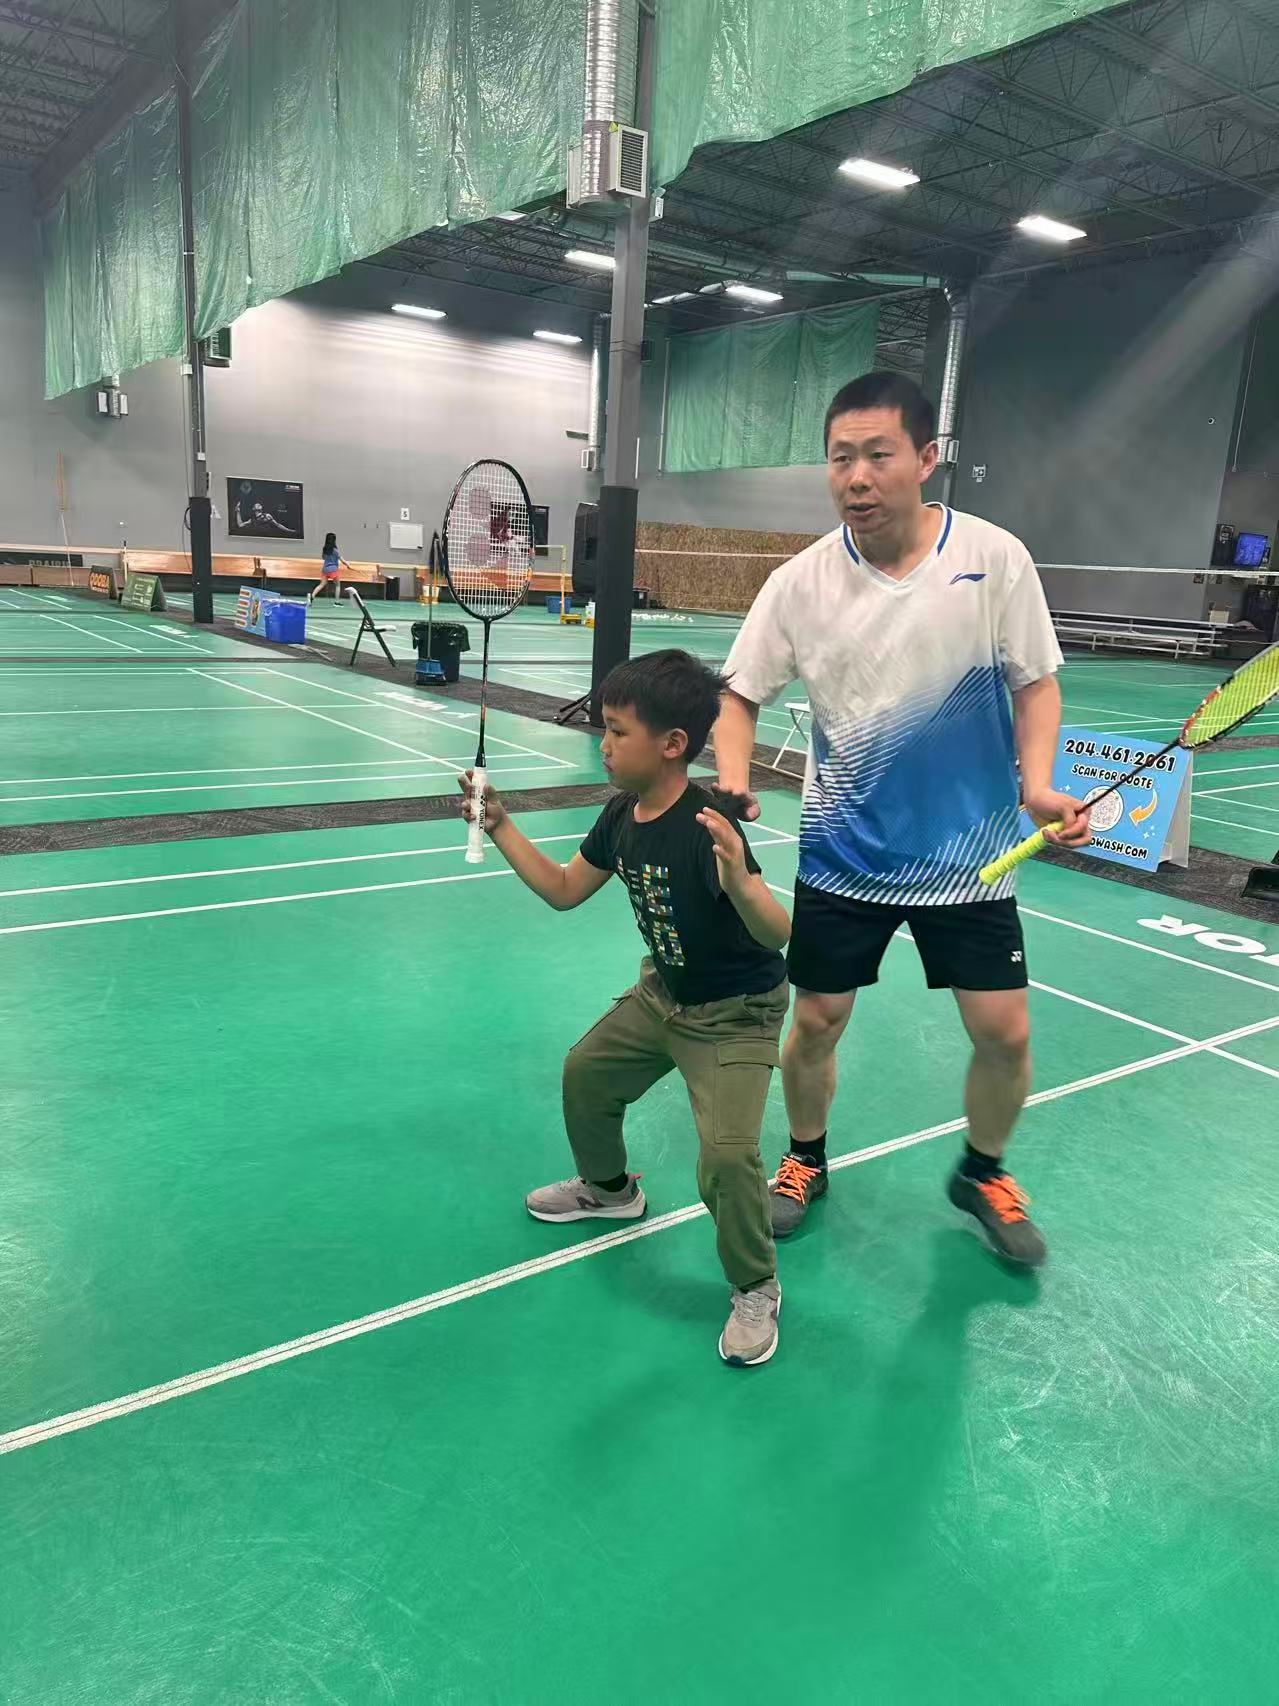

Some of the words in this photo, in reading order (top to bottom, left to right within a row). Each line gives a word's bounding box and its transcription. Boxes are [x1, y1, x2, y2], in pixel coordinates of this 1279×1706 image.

[1064, 739, 1177, 772] 204.461.2061
[1072, 763, 1098, 778] SCAN
[1098, 769, 1118, 782] FOR
[1119, 773, 1153, 789] QUOTE
